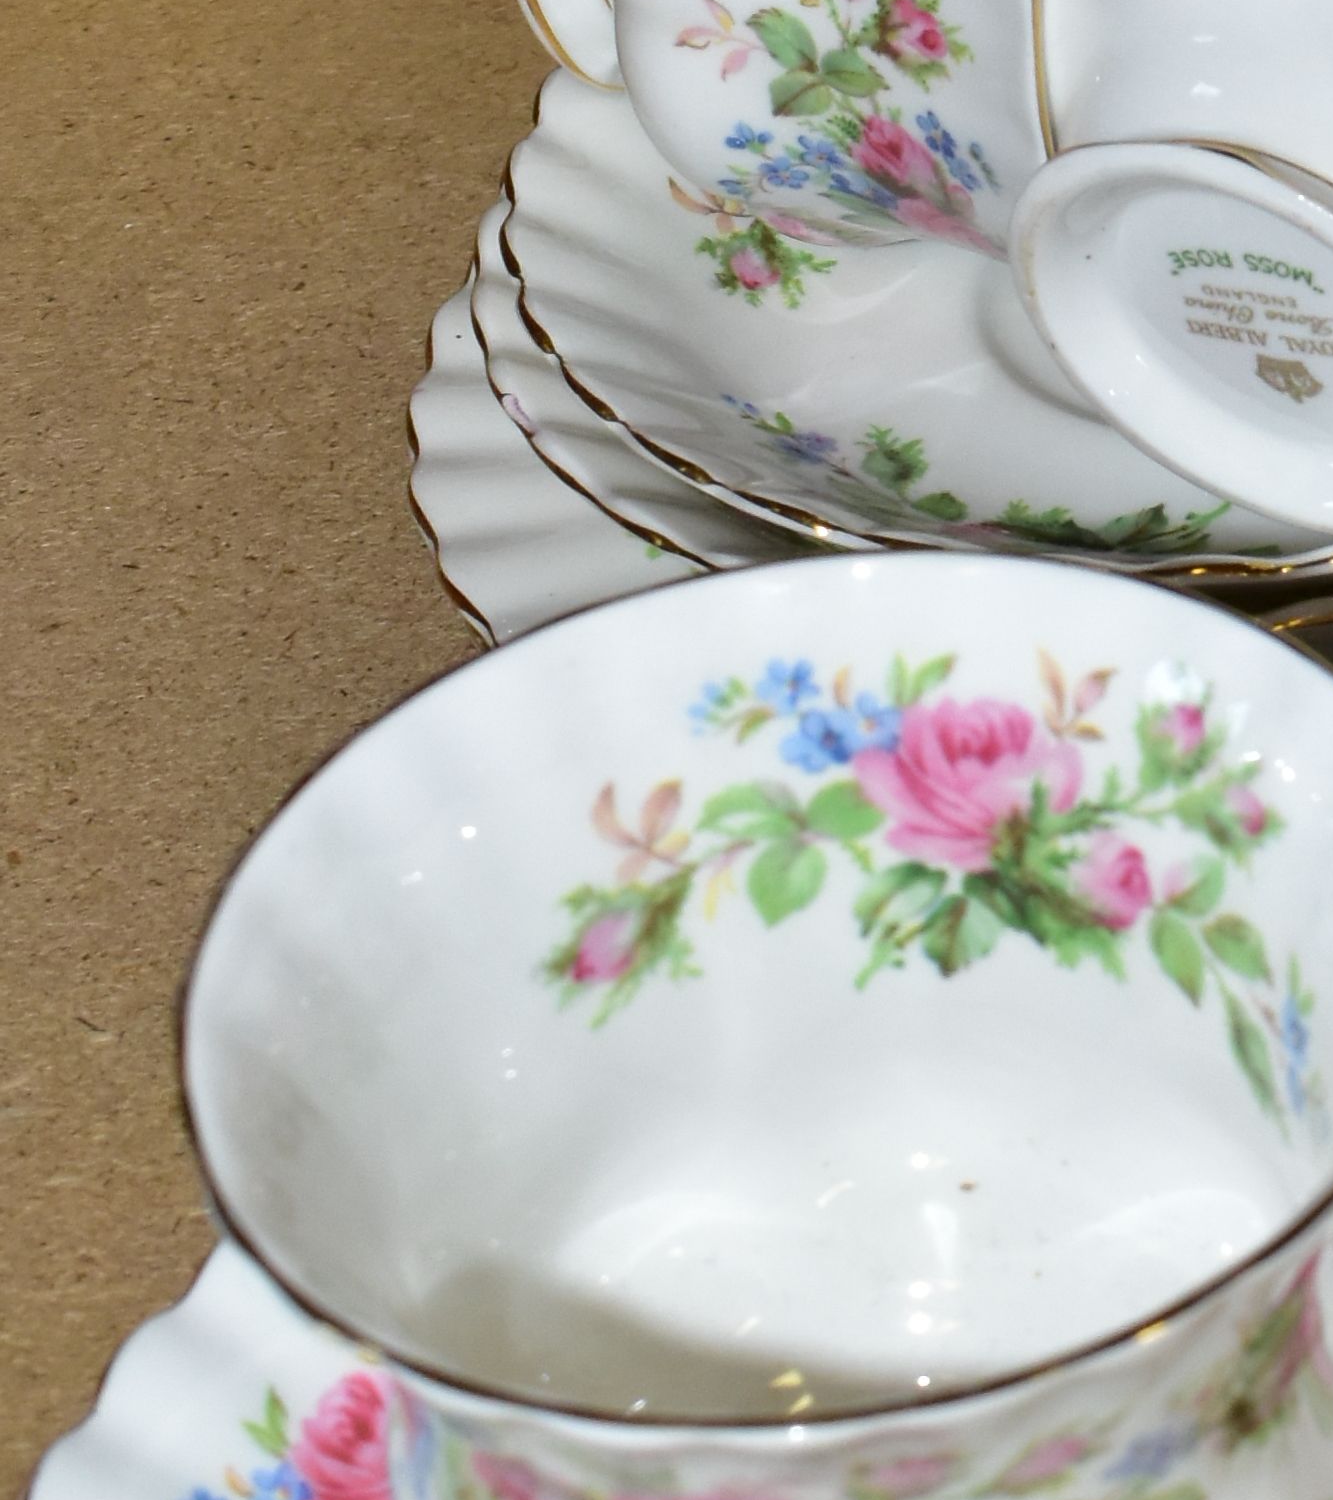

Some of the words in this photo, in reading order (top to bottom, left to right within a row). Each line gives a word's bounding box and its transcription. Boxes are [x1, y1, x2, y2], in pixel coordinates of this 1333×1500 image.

[1202, 285, 1296, 307] ENGLAND
[1184, 296, 1253, 323] China
[1187, 319, 1267, 344] ALBERT
